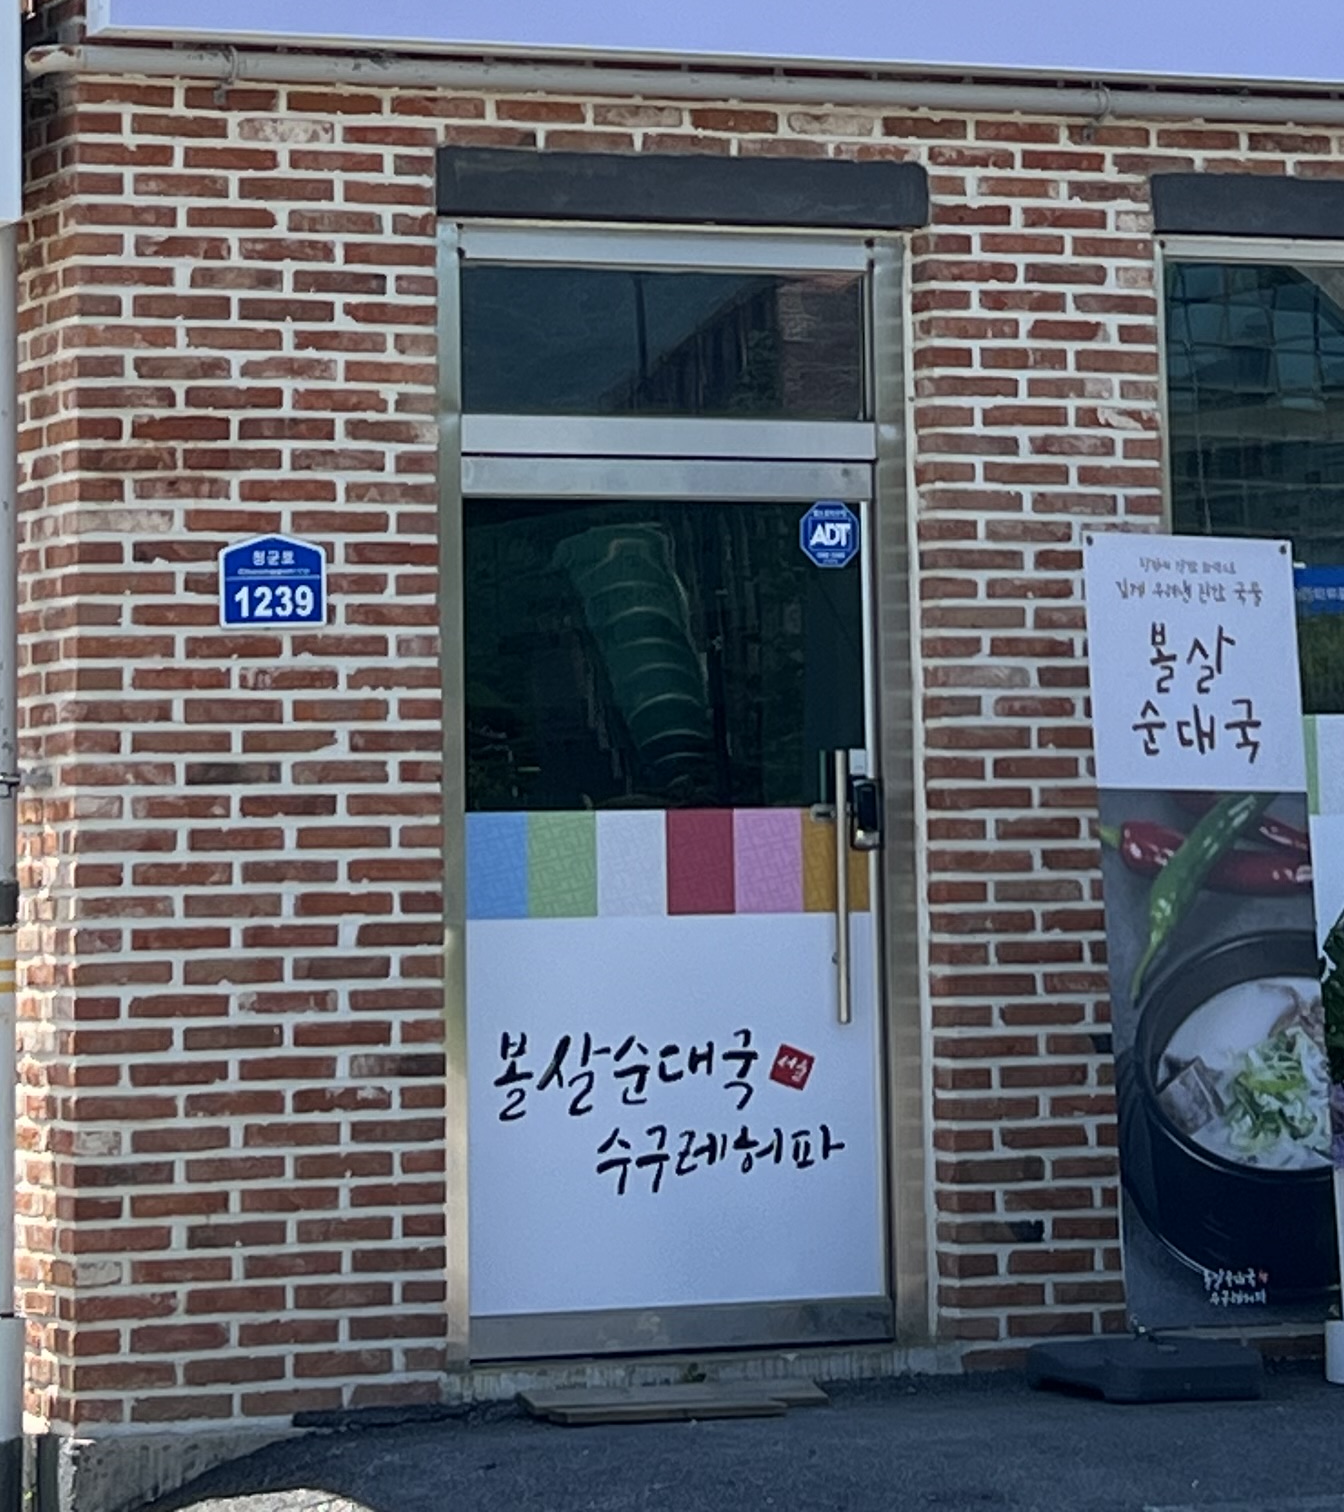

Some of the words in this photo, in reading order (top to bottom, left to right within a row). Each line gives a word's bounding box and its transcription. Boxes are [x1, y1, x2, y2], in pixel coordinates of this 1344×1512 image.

[810, 523, 851, 546] ADT
[234, 585, 315, 618] 1239
[1150, 621, 1236, 694] 볼살
[1132, 699, 1262, 764] 순대국
